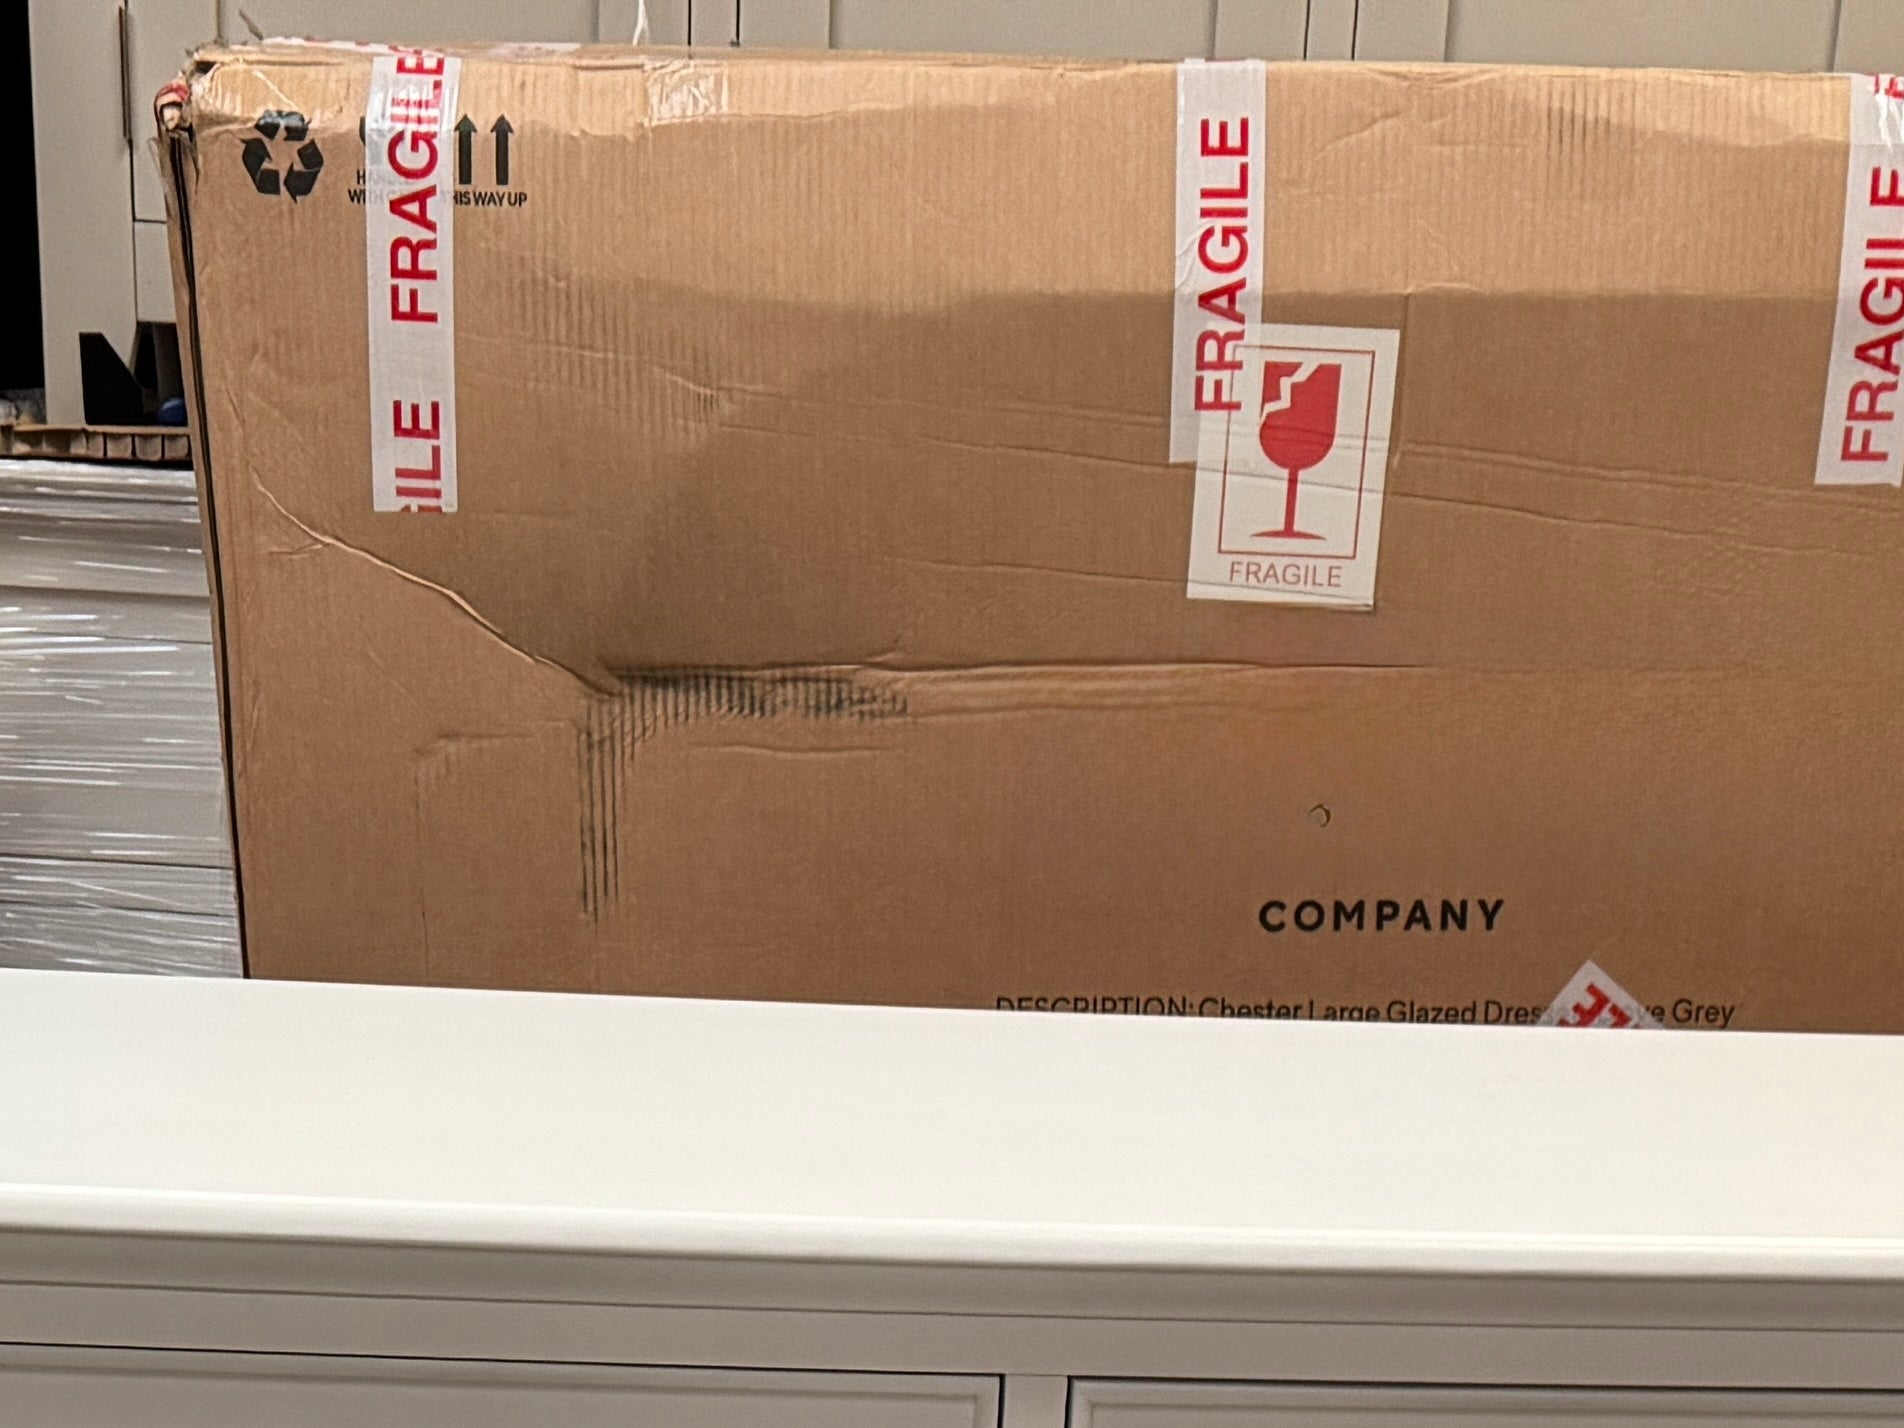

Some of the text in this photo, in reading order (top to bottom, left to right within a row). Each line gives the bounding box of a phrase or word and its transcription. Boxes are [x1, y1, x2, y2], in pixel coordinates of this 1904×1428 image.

[387, 50, 445, 323] FRAGILE
[472, 191, 505, 207] WAY
[507, 191, 528, 207] UP
[1194, 117, 1250, 412] FRAGILE
[1228, 560, 1343, 588] FRAGILE
[1258, 899, 1505, 932] COMPANY
[1198, 997, 1303, 1019] Chester
[1385, 1000, 1477, 1023] Glazed
[1672, 998, 1735, 1027] Grey
